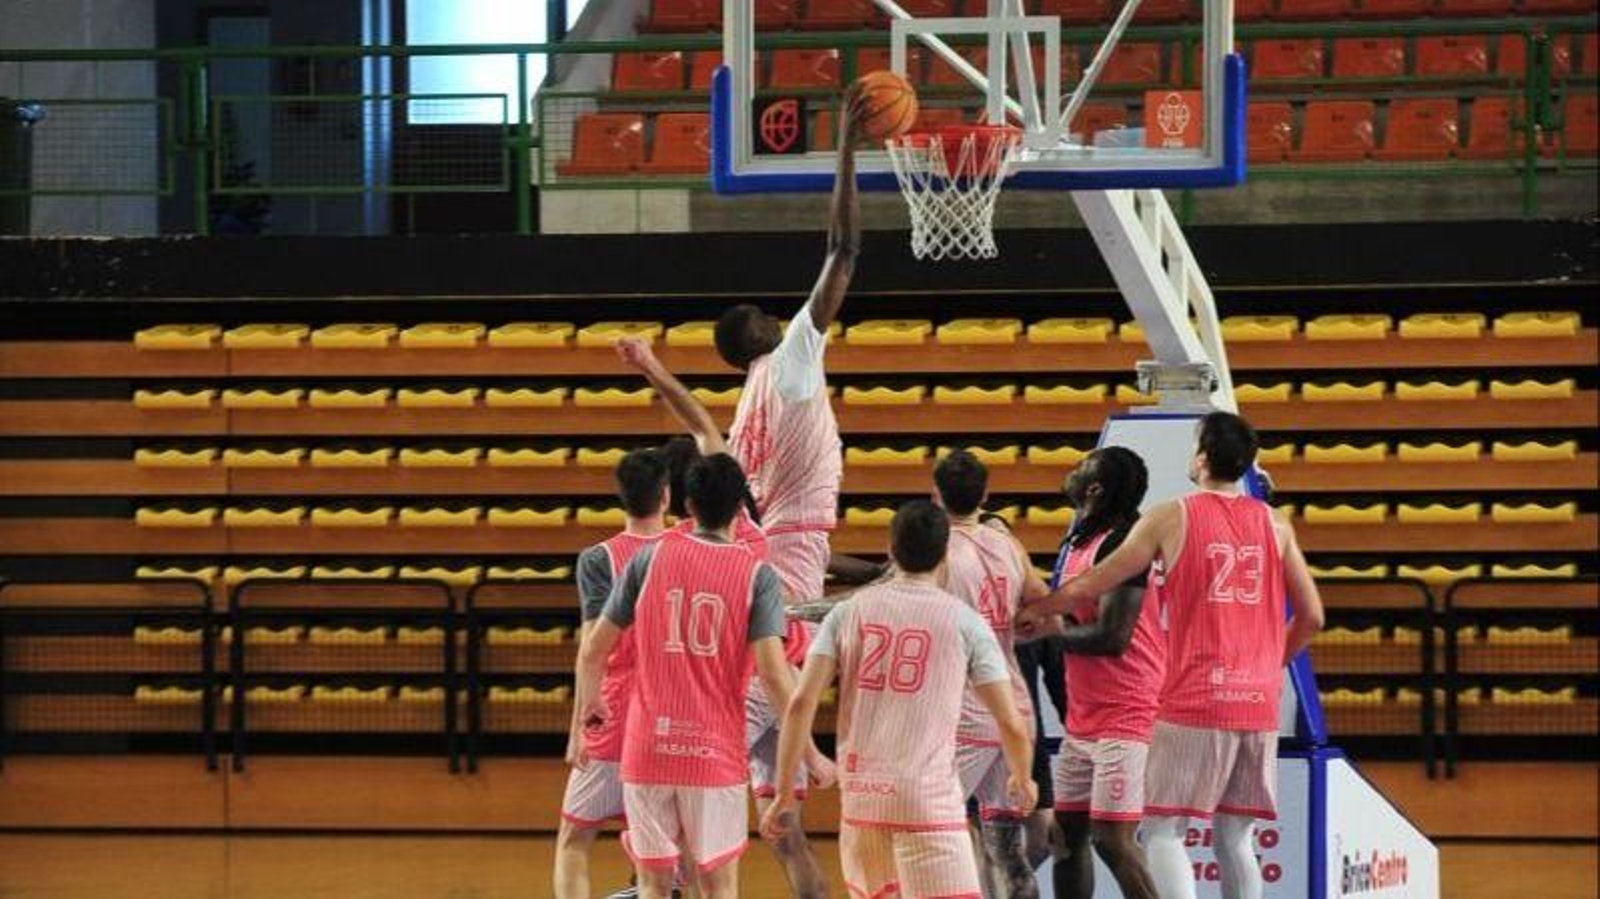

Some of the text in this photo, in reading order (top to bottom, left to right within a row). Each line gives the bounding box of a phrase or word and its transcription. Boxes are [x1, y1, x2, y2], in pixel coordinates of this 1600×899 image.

[1207, 543, 1265, 604] 23
[664, 589, 726, 656] 10
[858, 624, 931, 693] 28
